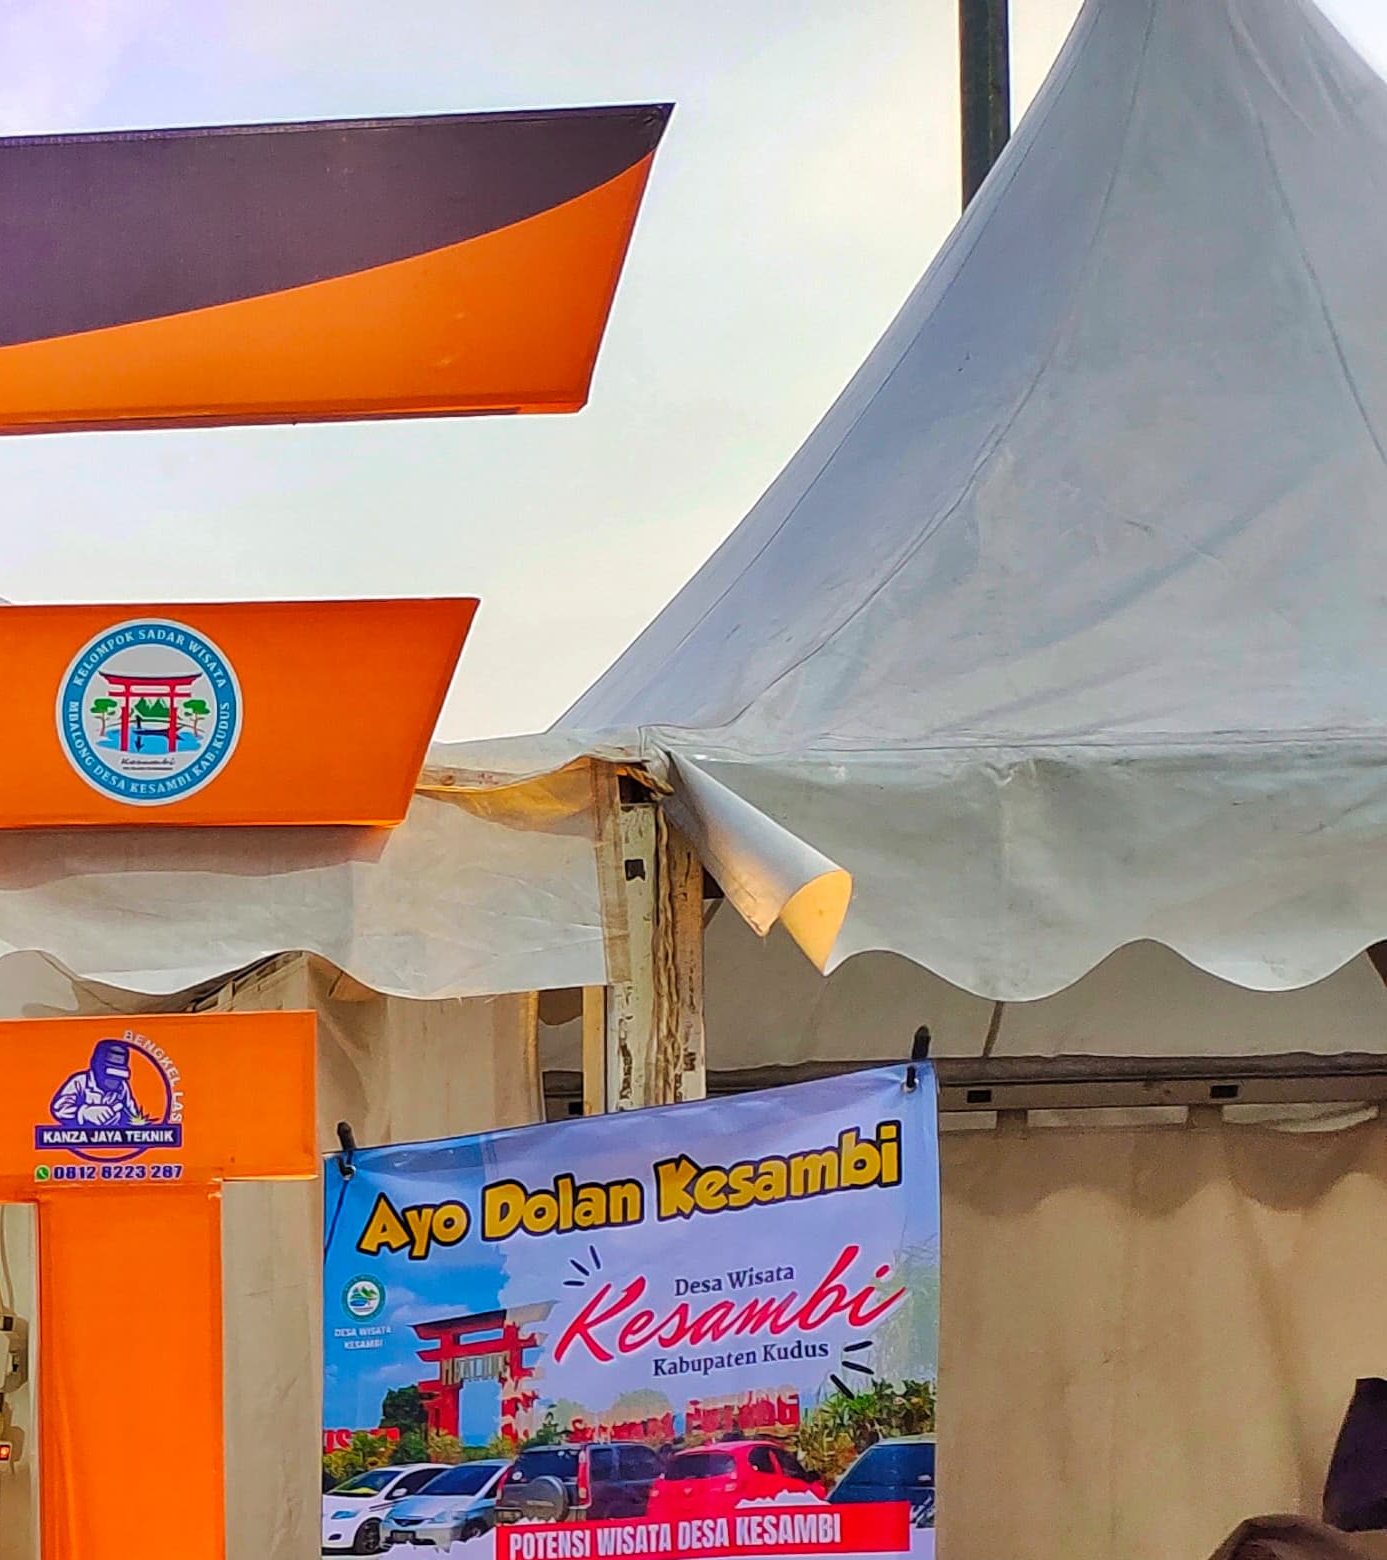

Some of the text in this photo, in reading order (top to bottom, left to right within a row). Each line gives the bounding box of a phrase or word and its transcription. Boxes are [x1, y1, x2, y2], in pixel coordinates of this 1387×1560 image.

[73, 629, 228, 689] KELOMPOK SADAR WISATA
[92, 764, 126, 791] DESA
[123, 1029, 185, 1122] BENGKEL LAS
[43, 1129, 175, 1144] KANZA JAYA TEKNIK
[53, 1165, 97, 1180] 0812
[357, 1120, 903, 1261] Ayo Dolan Kesambi
[674, 1263, 795, 1298] Desa Wisata
[553, 1244, 907, 1364] Kesambi
[651, 1340, 829, 1379] Kabupaten Kudus
[596, 1522, 672, 1557] WISATA
[677, 1517, 729, 1550] DESA
[735, 1512, 841, 1545] KESAMBI
